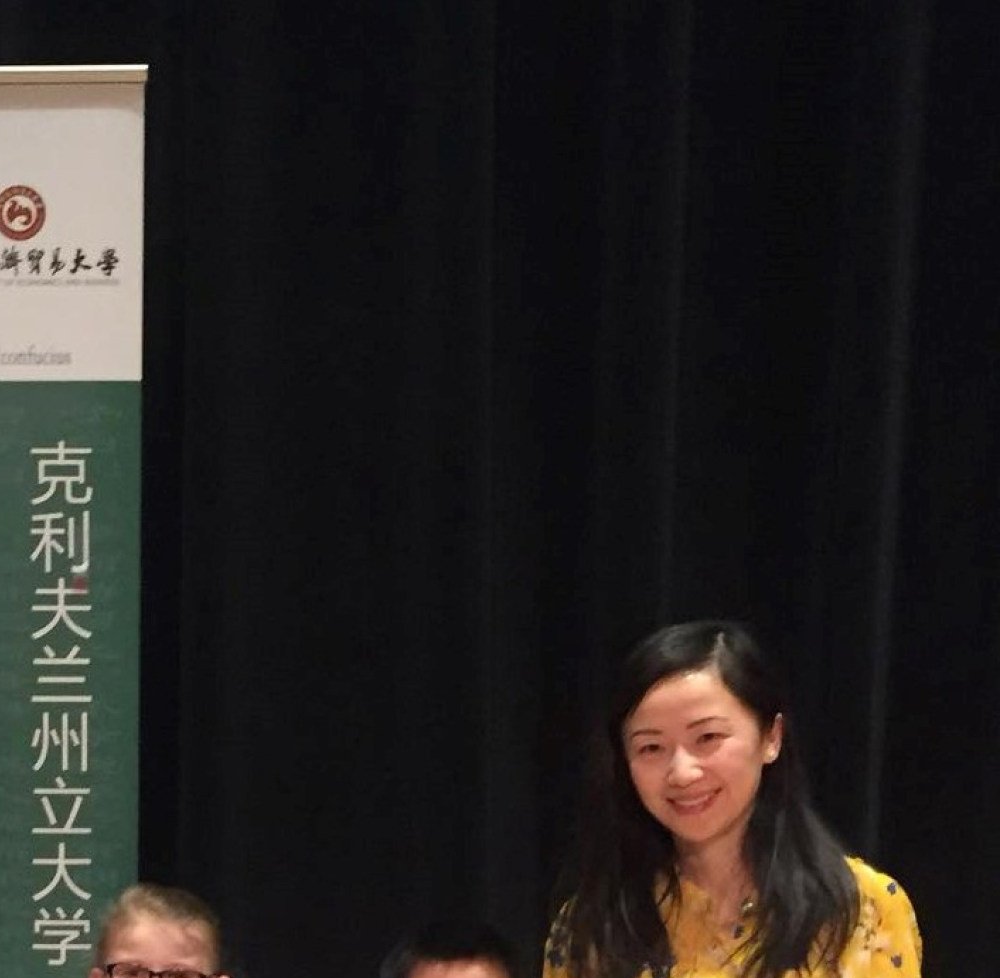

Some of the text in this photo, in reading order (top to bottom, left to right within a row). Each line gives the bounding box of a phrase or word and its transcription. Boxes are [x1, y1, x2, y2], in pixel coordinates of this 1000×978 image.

[30, 440, 93, 966] 克利夫兰州立大学
